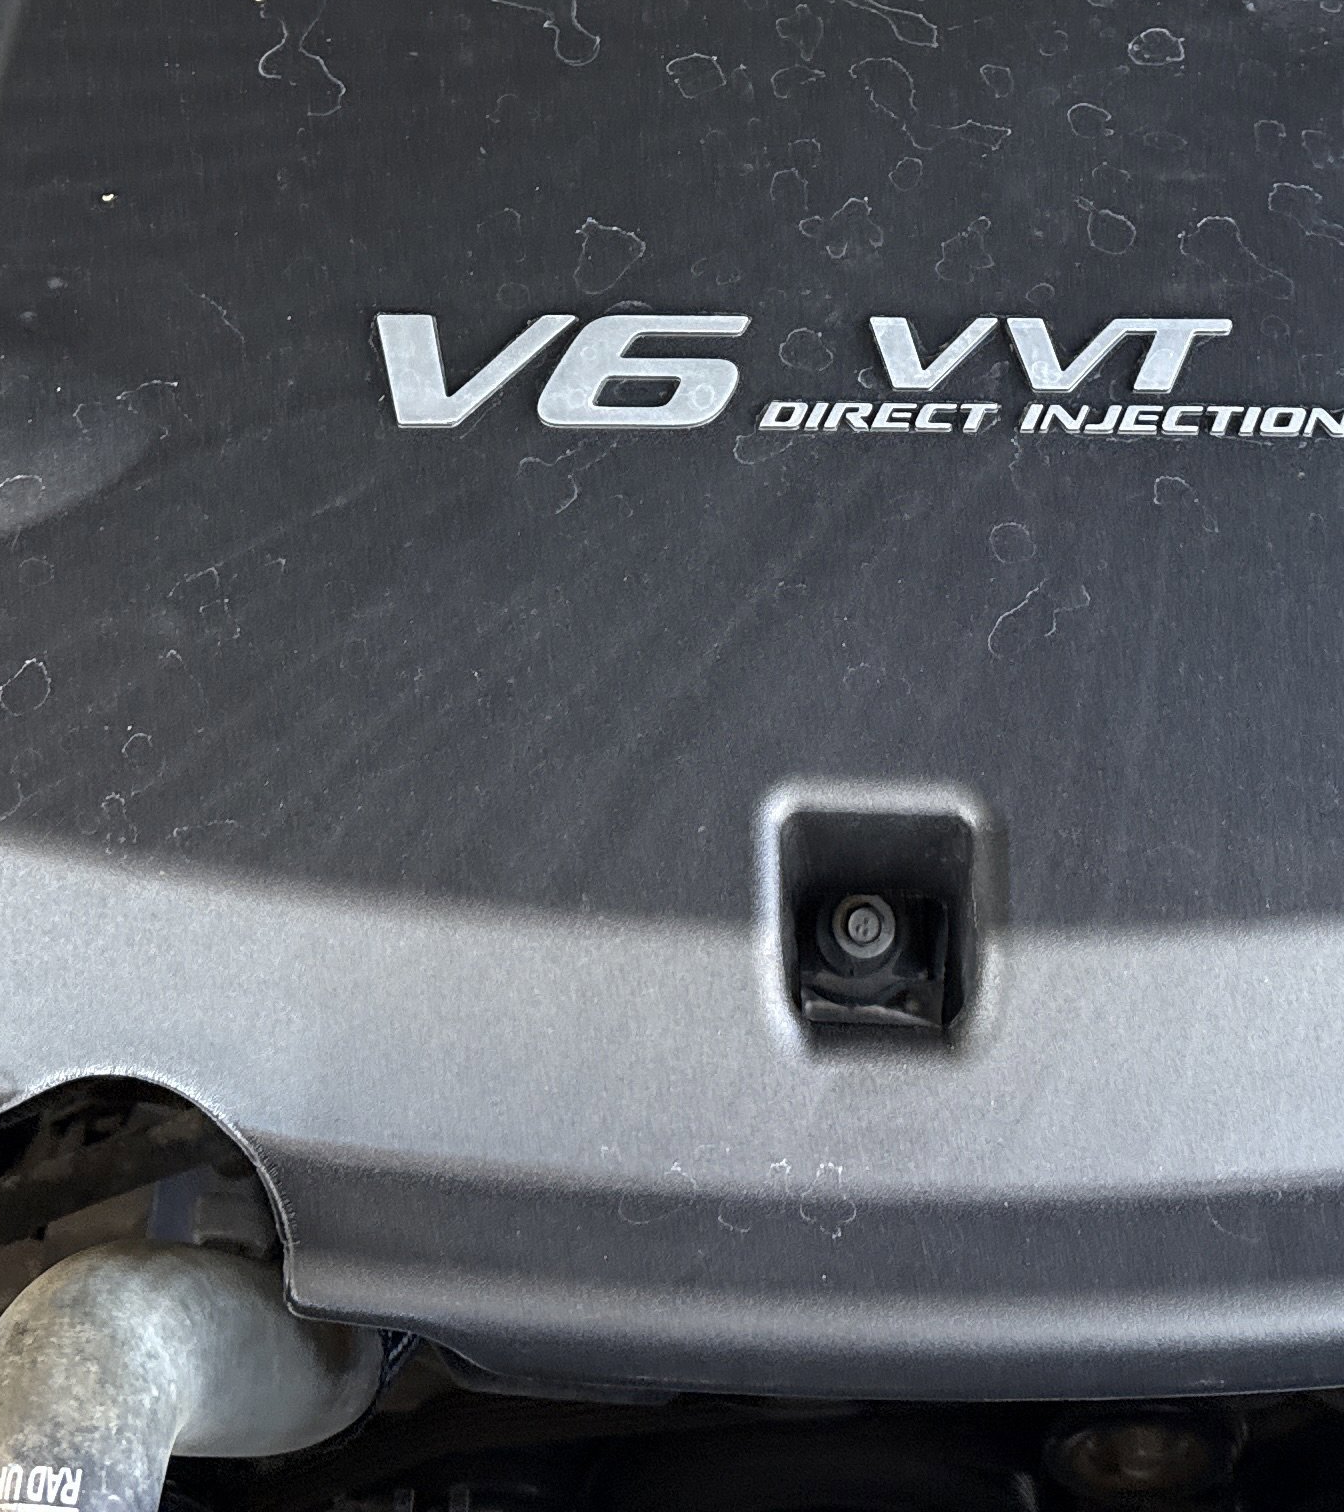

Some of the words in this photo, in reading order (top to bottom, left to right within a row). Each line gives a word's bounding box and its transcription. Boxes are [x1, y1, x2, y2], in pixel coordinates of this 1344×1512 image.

[376, 313, 752, 429] V6
[869, 316, 1233, 393] VVT
[758, 400, 1001, 434] DIRECT
[26, 1465, 83, 1506] RAD
